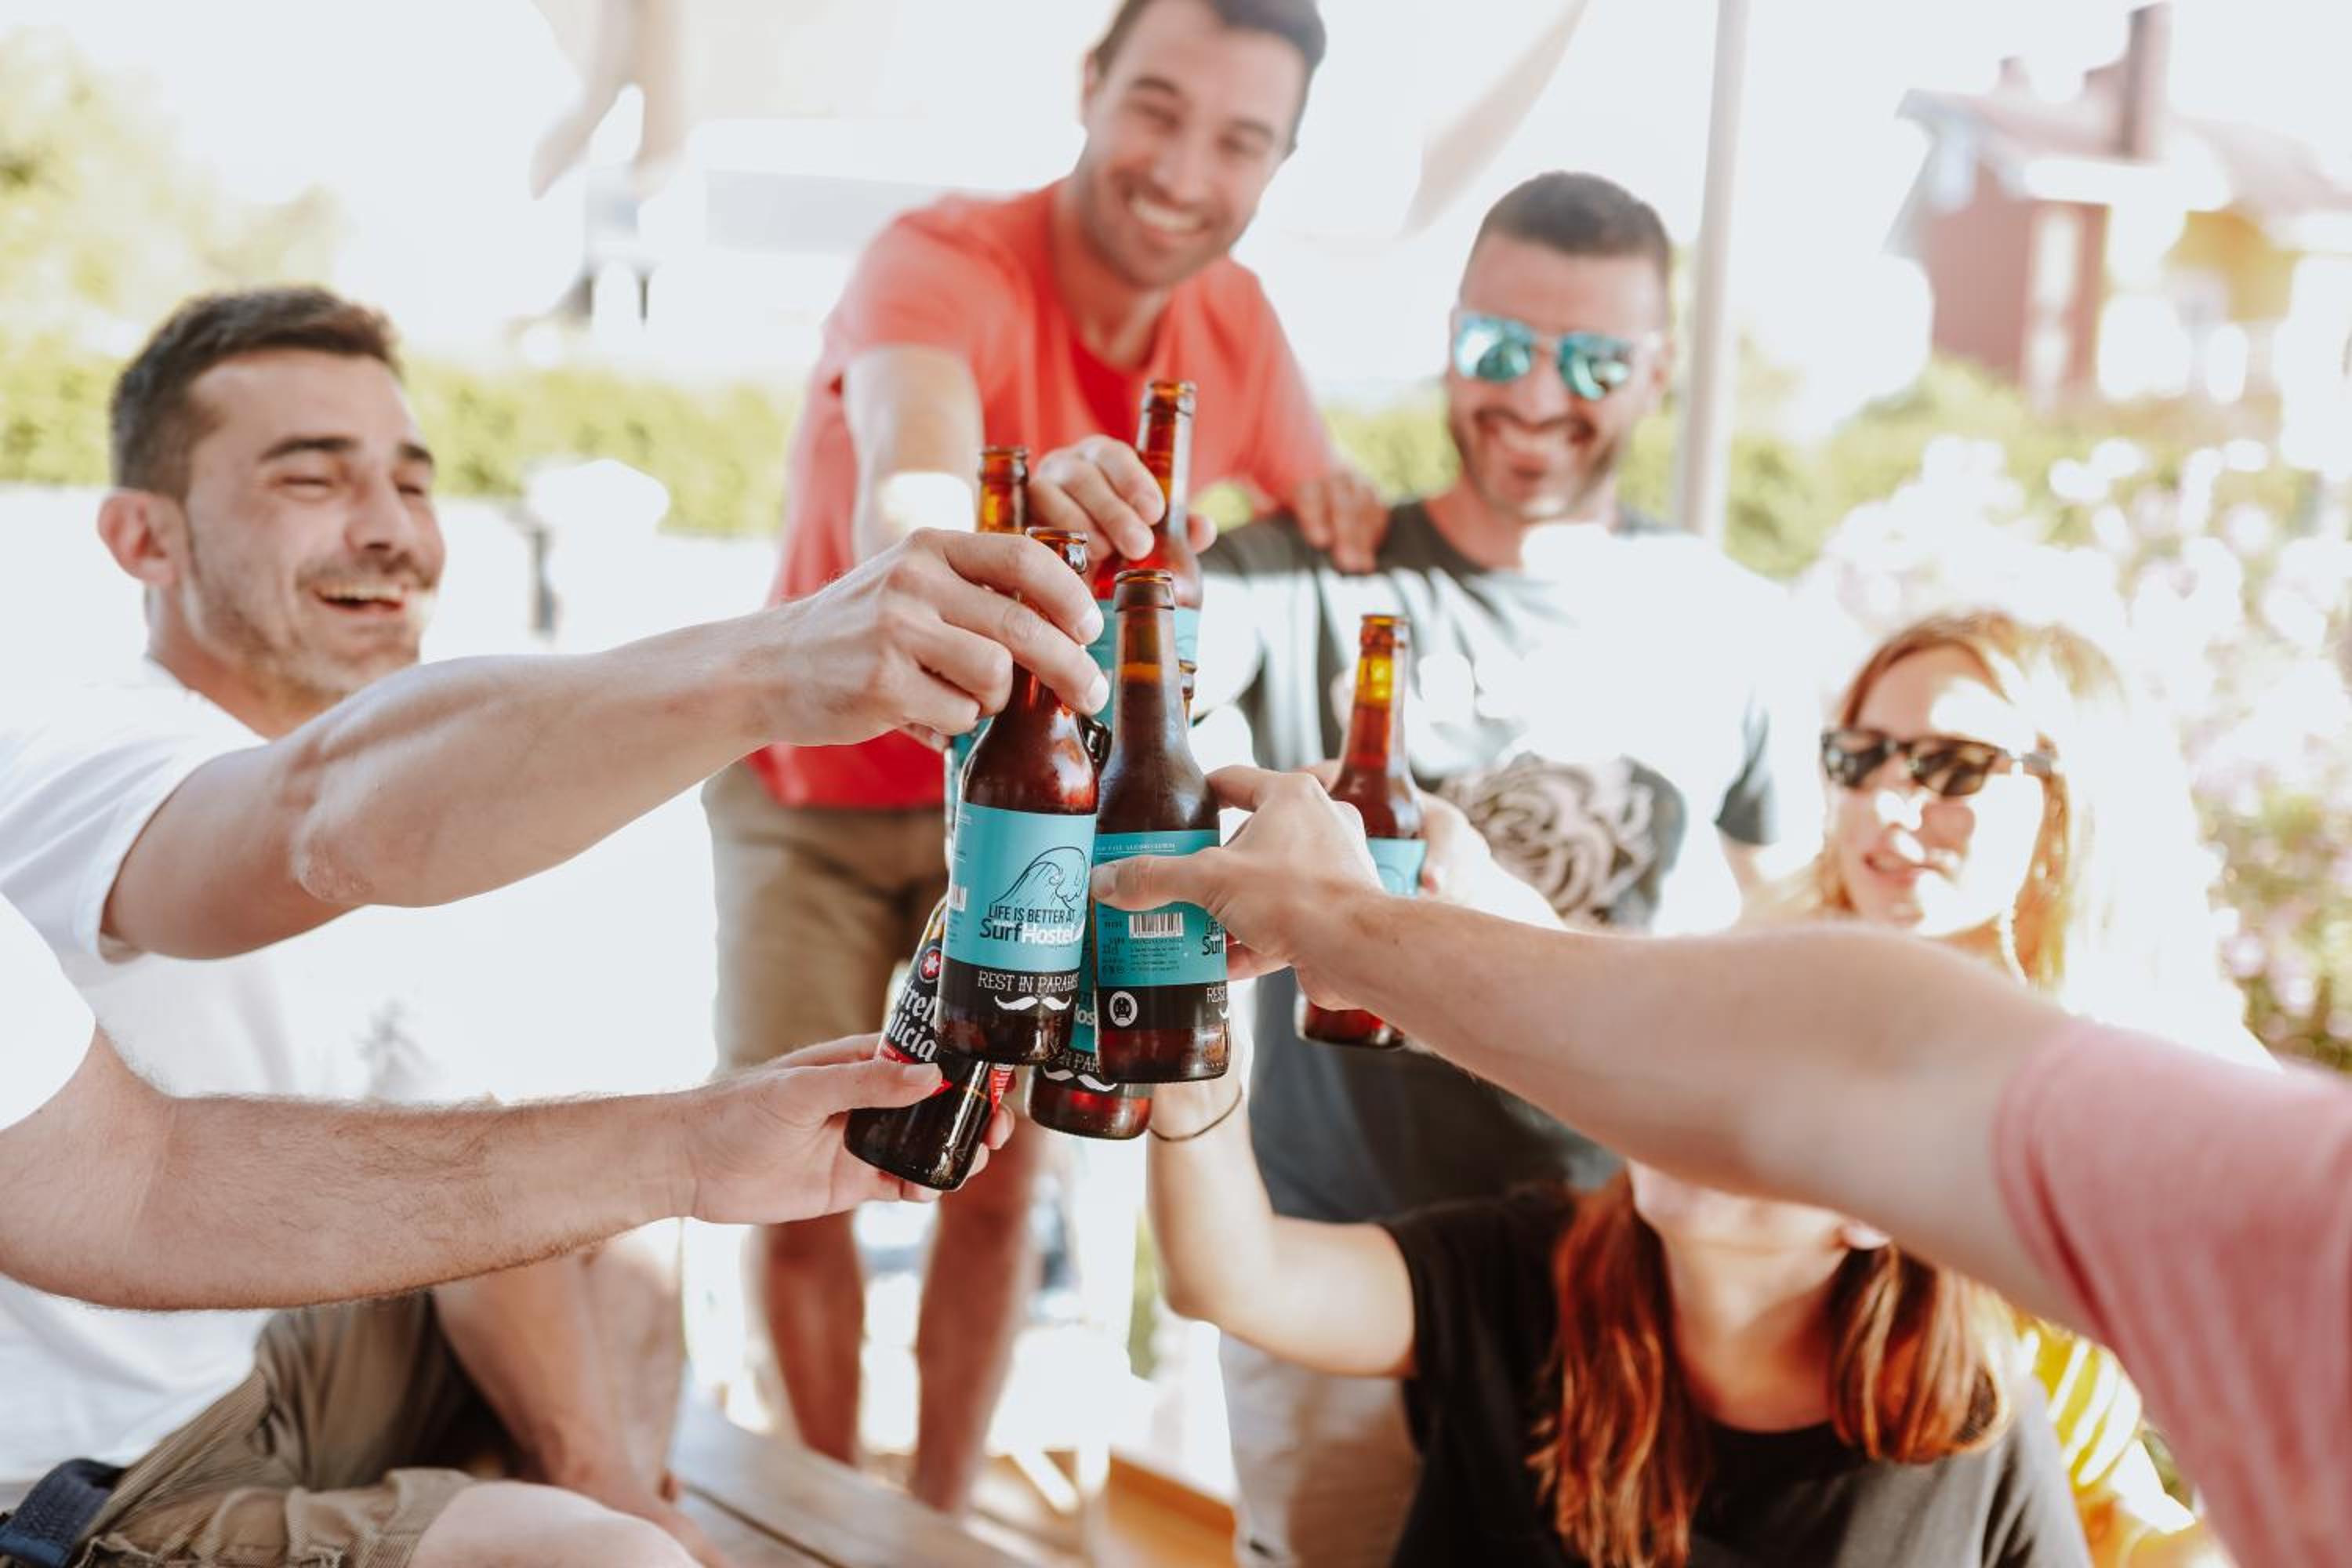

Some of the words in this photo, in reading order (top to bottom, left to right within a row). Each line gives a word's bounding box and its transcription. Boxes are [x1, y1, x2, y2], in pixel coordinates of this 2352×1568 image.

[989, 904, 1011, 920] LIFE
[1014, 906, 1025, 922] IS
[1027, 909, 1065, 924] BETTER
[1066, 909, 1076, 923] AT
[978, 970, 1015, 991] REST
[1018, 975, 1034, 993] IN
